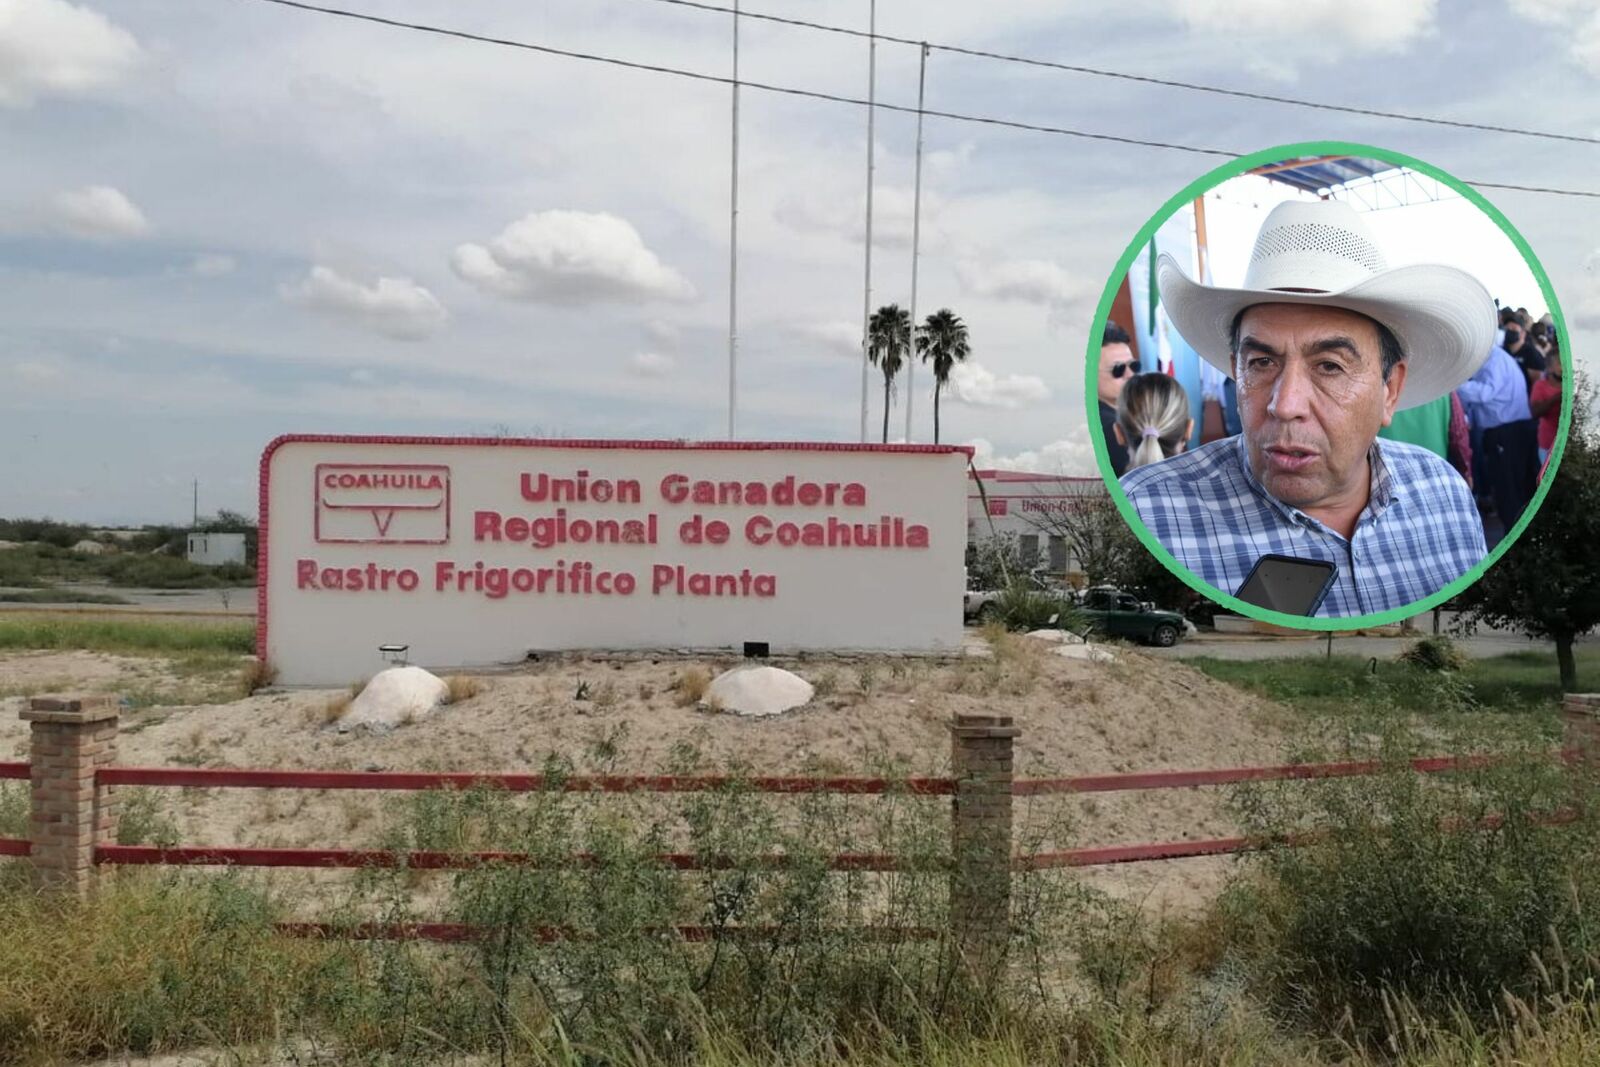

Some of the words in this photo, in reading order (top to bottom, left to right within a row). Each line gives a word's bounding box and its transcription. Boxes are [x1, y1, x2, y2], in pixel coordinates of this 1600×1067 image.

[325, 473, 443, 490] COAHUILA
[520, 469, 641, 504] Union
[660, 475, 866, 507] Ganadera
[474, 510, 658, 549] Regional
[679, 515, 730, 545] de
[745, 515, 929, 548] Coahuila
[297, 560, 420, 591] Rastro
[434, 560, 636, 599] Frigorifico
[653, 565, 776, 596] Planta
